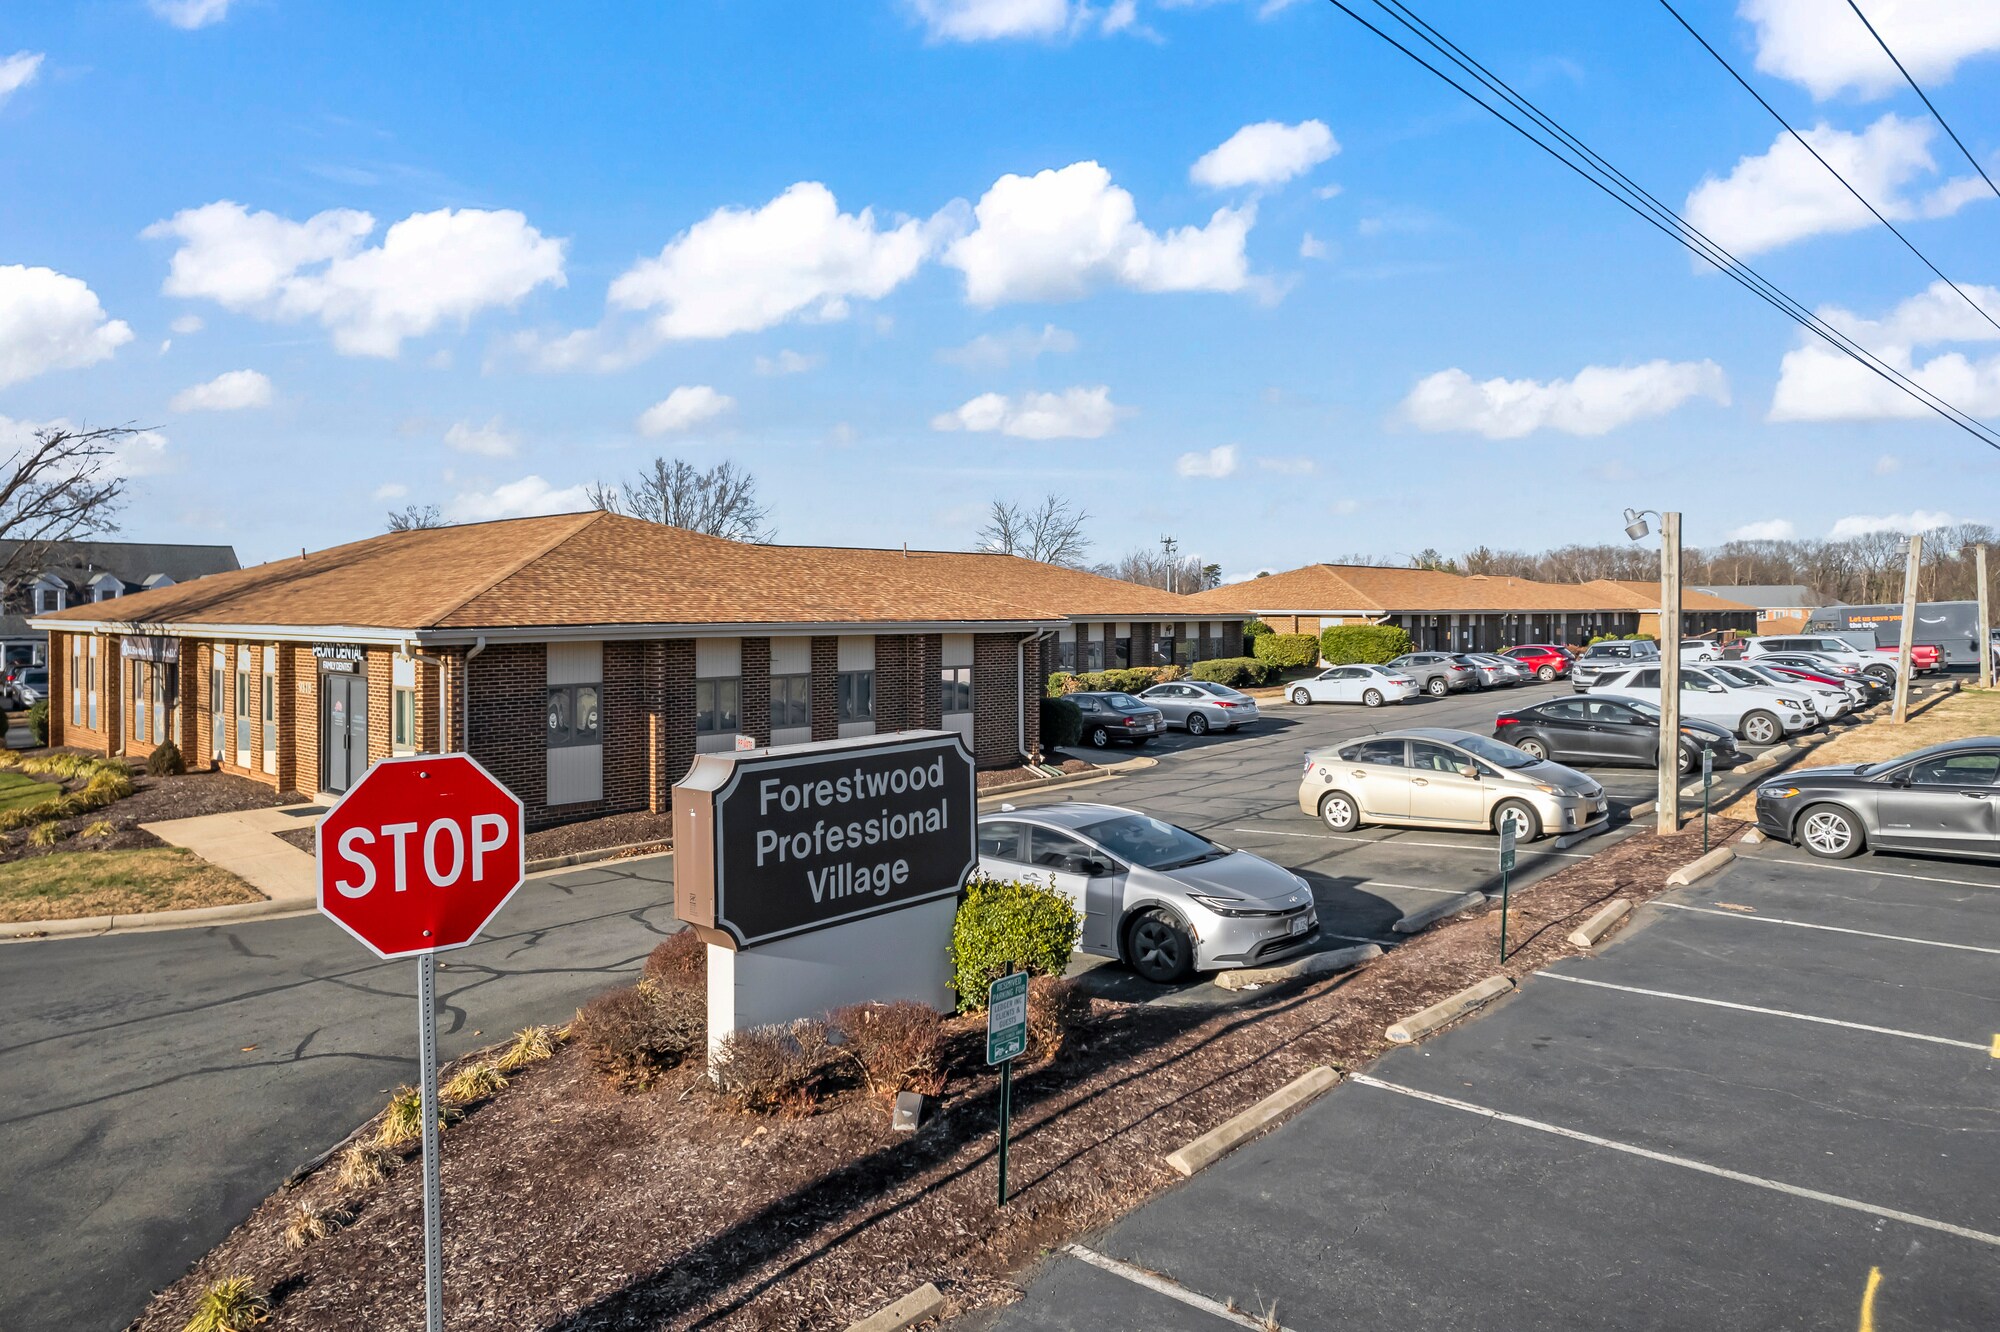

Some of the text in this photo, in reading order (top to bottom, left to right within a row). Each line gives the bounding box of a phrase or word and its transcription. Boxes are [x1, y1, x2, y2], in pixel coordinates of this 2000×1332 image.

[312, 643, 363, 660] PEONY DENTAL
[759, 755, 944, 815] Forestwood
[756, 798, 948, 867] Professional
[335, 813, 509, 899] STOP
[806, 858, 909, 903] Village
[992, 984, 1025, 1003] PARKING FOR
[996, 977, 1022, 991] RESERVED
